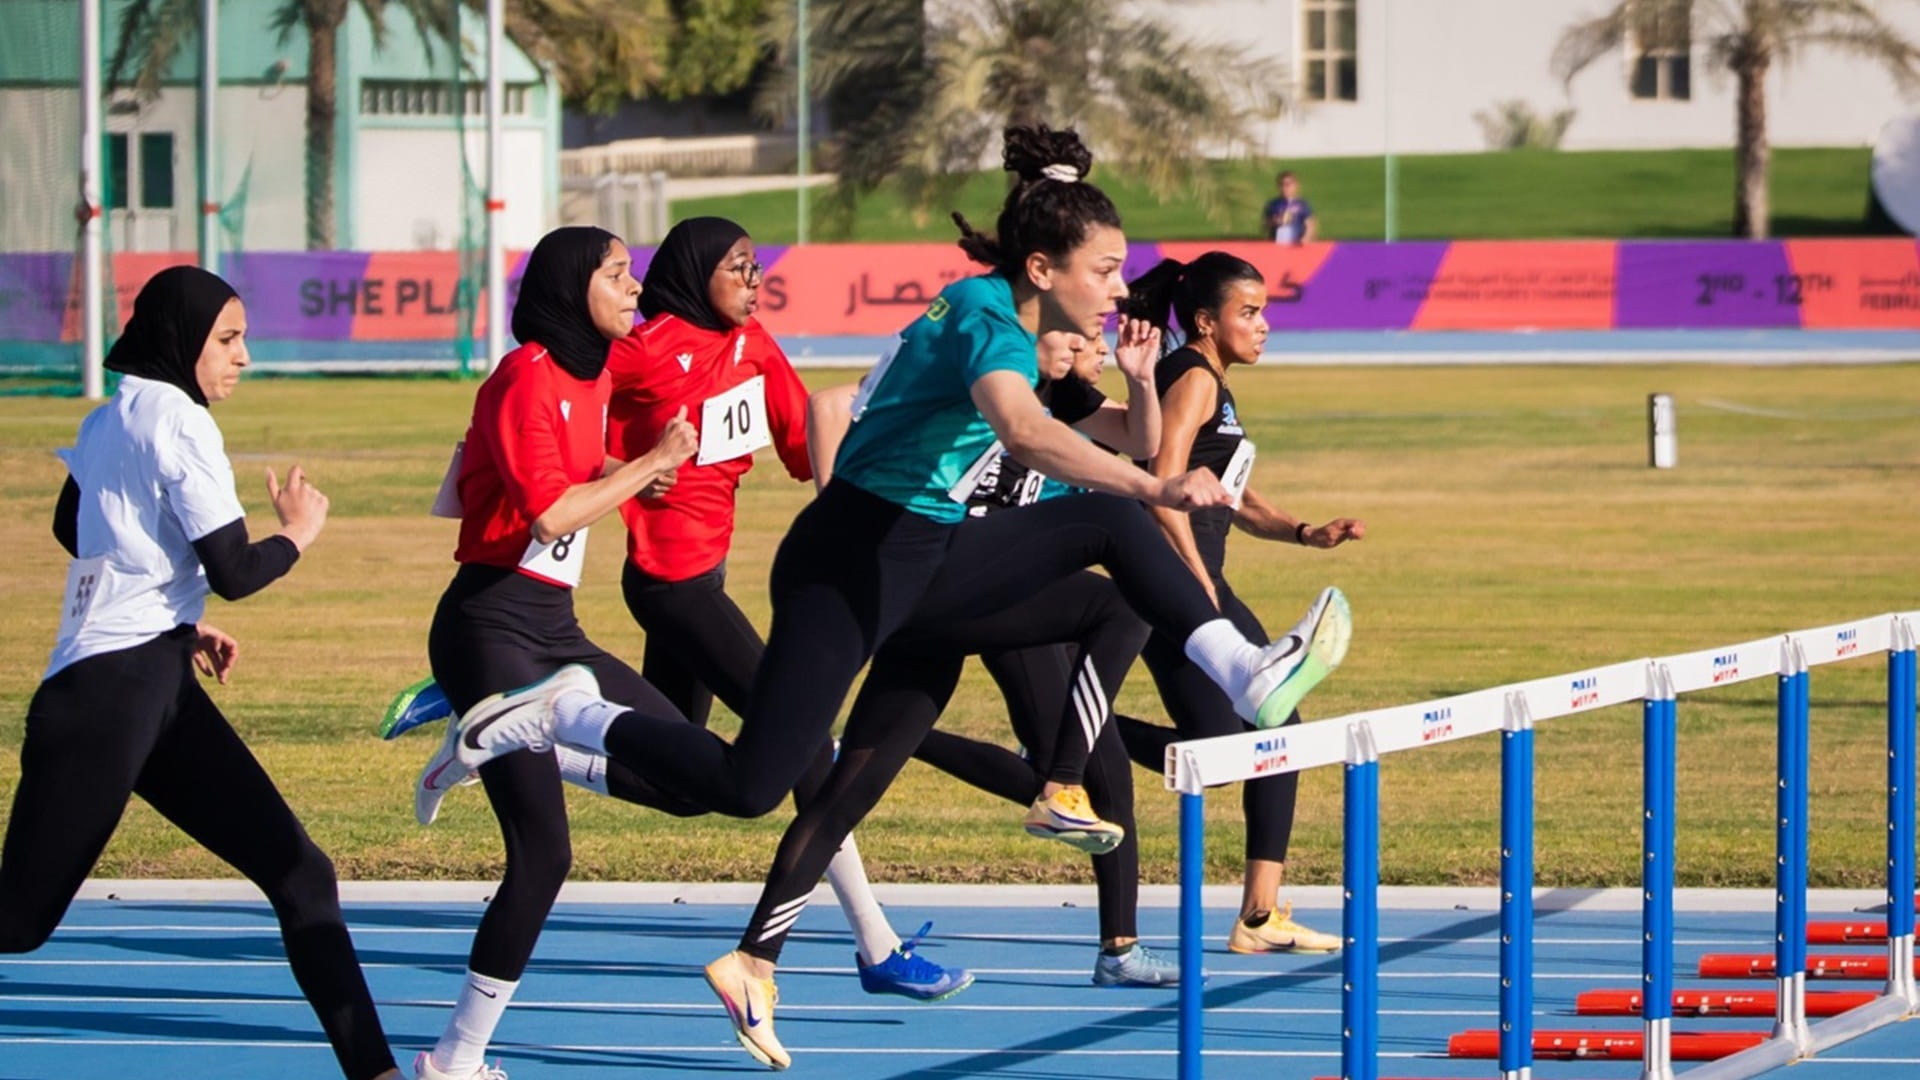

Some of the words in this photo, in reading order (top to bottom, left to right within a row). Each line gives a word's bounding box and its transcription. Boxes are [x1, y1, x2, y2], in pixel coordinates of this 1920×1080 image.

[301, 279, 384, 316] SHE
[396, 279, 484, 316] PLA
[723, 400, 751, 440] 10
[1234, 458, 1250, 488] 8
[551, 532, 576, 562] 8
